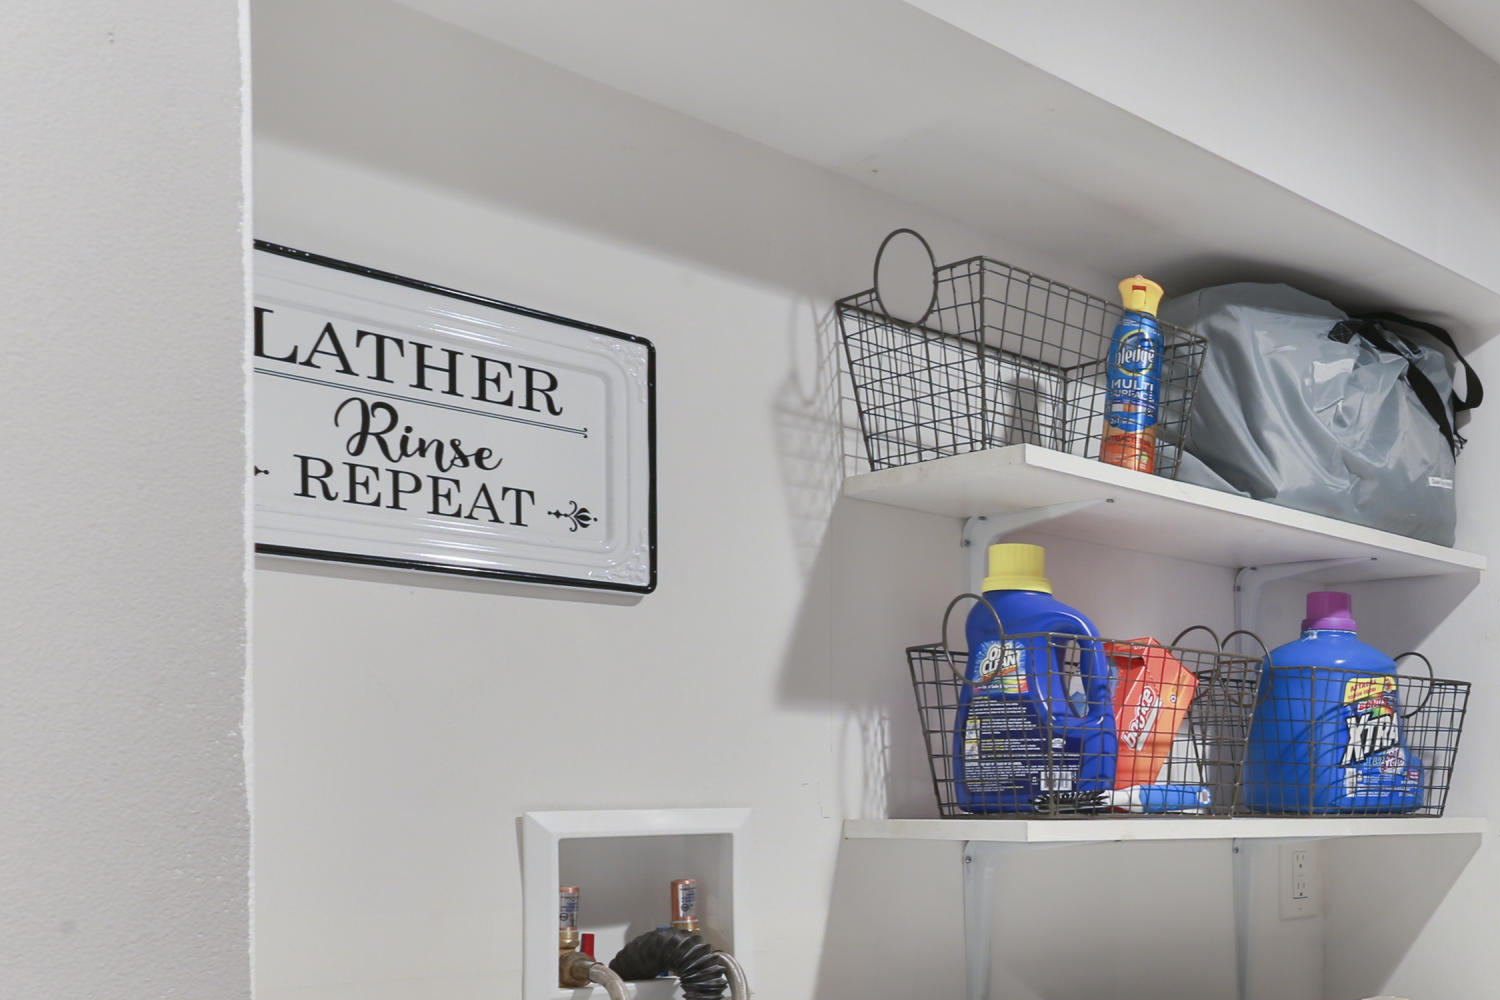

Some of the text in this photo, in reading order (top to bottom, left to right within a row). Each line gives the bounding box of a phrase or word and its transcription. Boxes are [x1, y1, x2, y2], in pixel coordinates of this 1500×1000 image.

[253, 306, 563, 417] LATHER
[1112, 379, 1153, 392] MULTI
[334, 397, 502, 473] Rinse
[293, 454, 535, 527] REPEAT
[1341, 712, 1399, 765] XTRA
